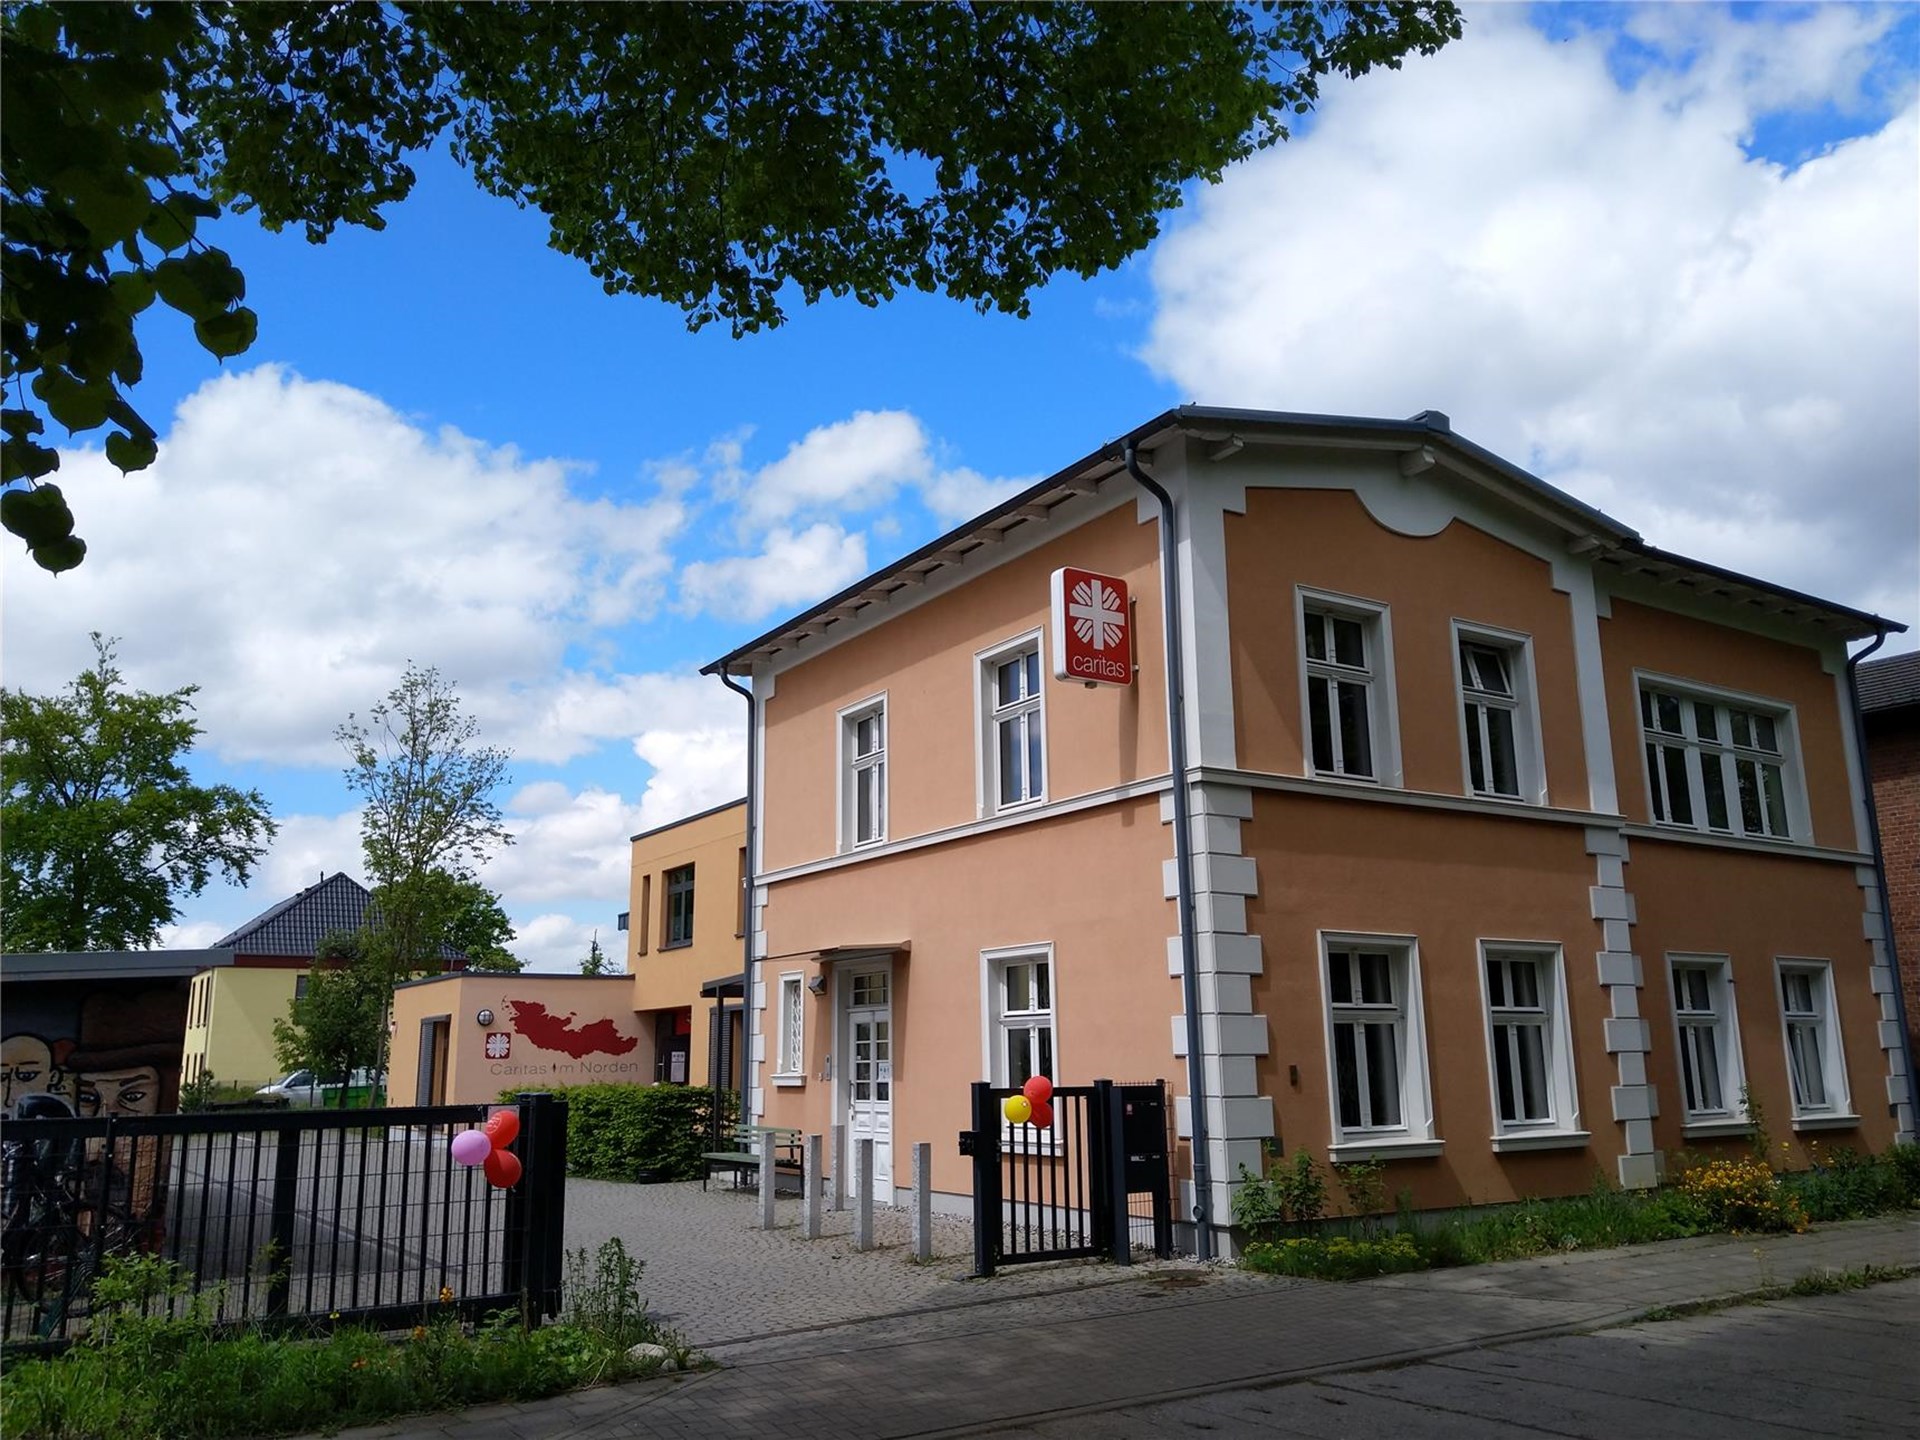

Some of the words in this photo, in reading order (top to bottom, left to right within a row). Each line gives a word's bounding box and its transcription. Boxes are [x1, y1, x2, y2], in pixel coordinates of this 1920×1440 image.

[1073, 655, 1125, 677] caritas
[490, 1062, 547, 1075] Caritas
[580, 1060, 638, 1073] Norden
